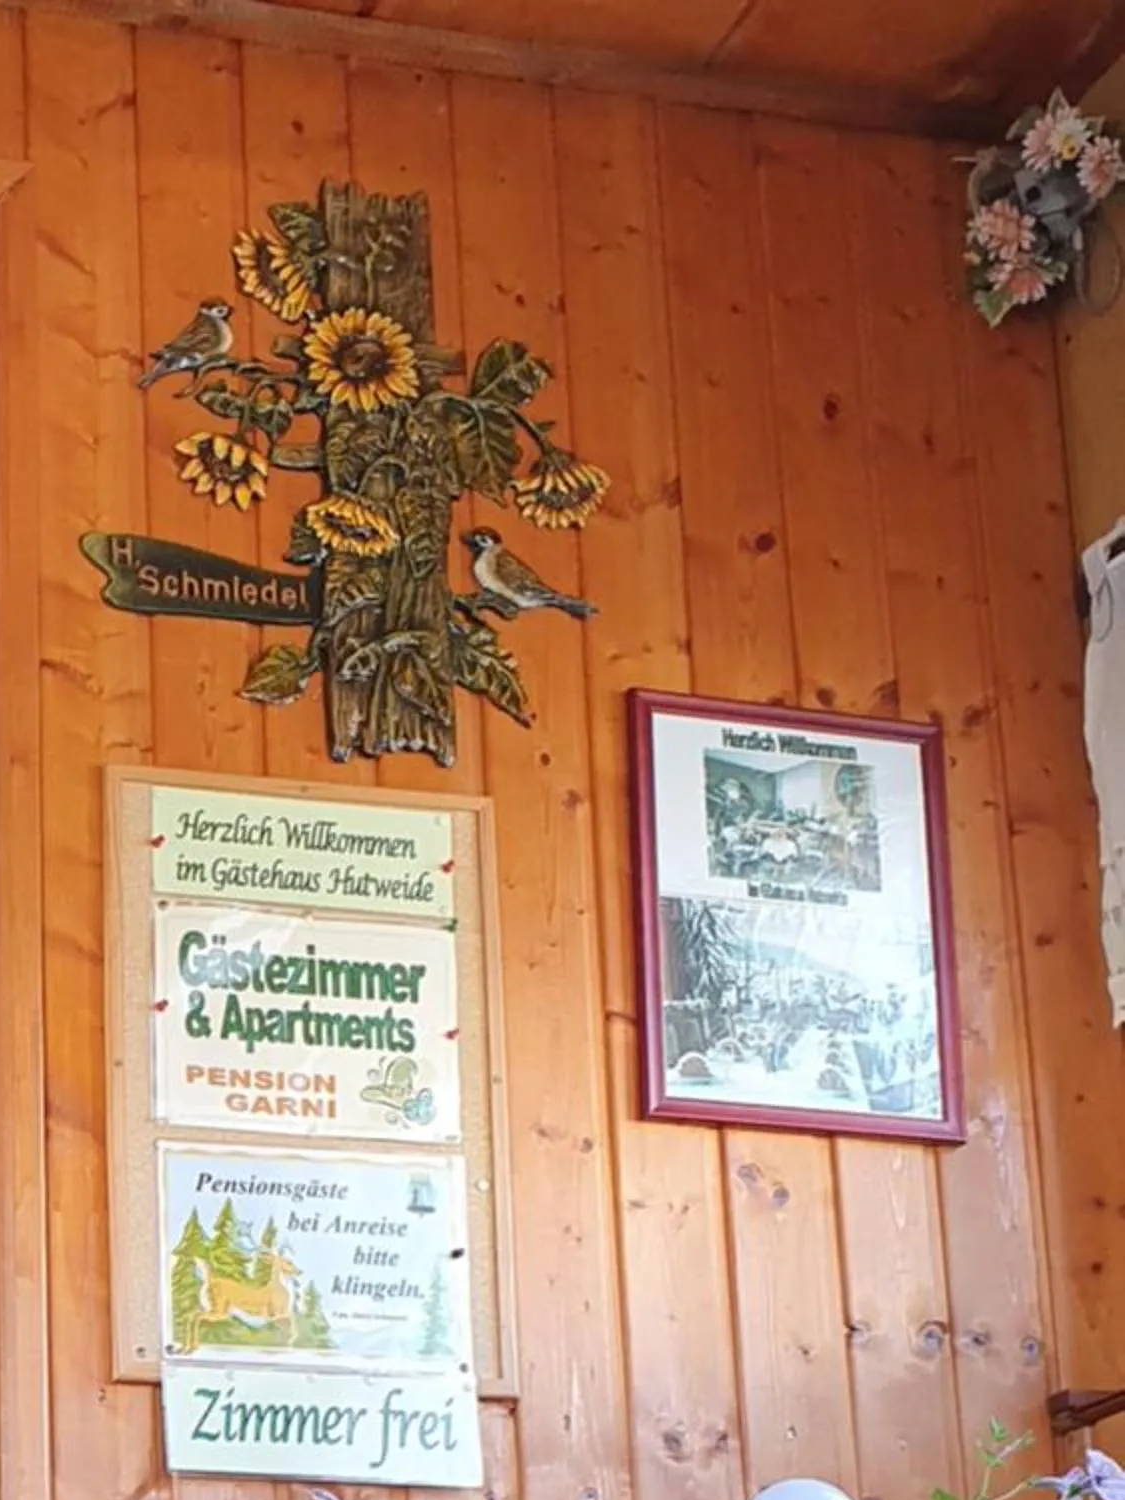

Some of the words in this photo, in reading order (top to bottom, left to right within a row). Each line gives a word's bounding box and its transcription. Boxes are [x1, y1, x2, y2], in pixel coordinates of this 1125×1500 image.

[176, 810, 274, 847] Herzlich
[278, 816, 417, 859] Willkommen
[176, 854, 206, 881] im
[211, 857, 322, 893] Gästehaus
[327, 867, 434, 902] Hutweide
[178, 930, 426, 1004] Gästezimmer
[184, 990, 211, 1039] &
[220, 993, 416, 1053] Apartments
[185, 1065, 336, 1093] PENSION
[225, 1094, 337, 1119] GARNI
[195, 1172, 349, 1202] Pensionsgäste
[287, 1212, 319, 1232] bei
[325, 1215, 408, 1238] Anreise
[353, 1246, 400, 1268] bitte
[331, 1275, 425, 1301] klingeln.
[192, 1387, 368, 1446] Zimmer
[369, 1388, 458, 1467] frei
